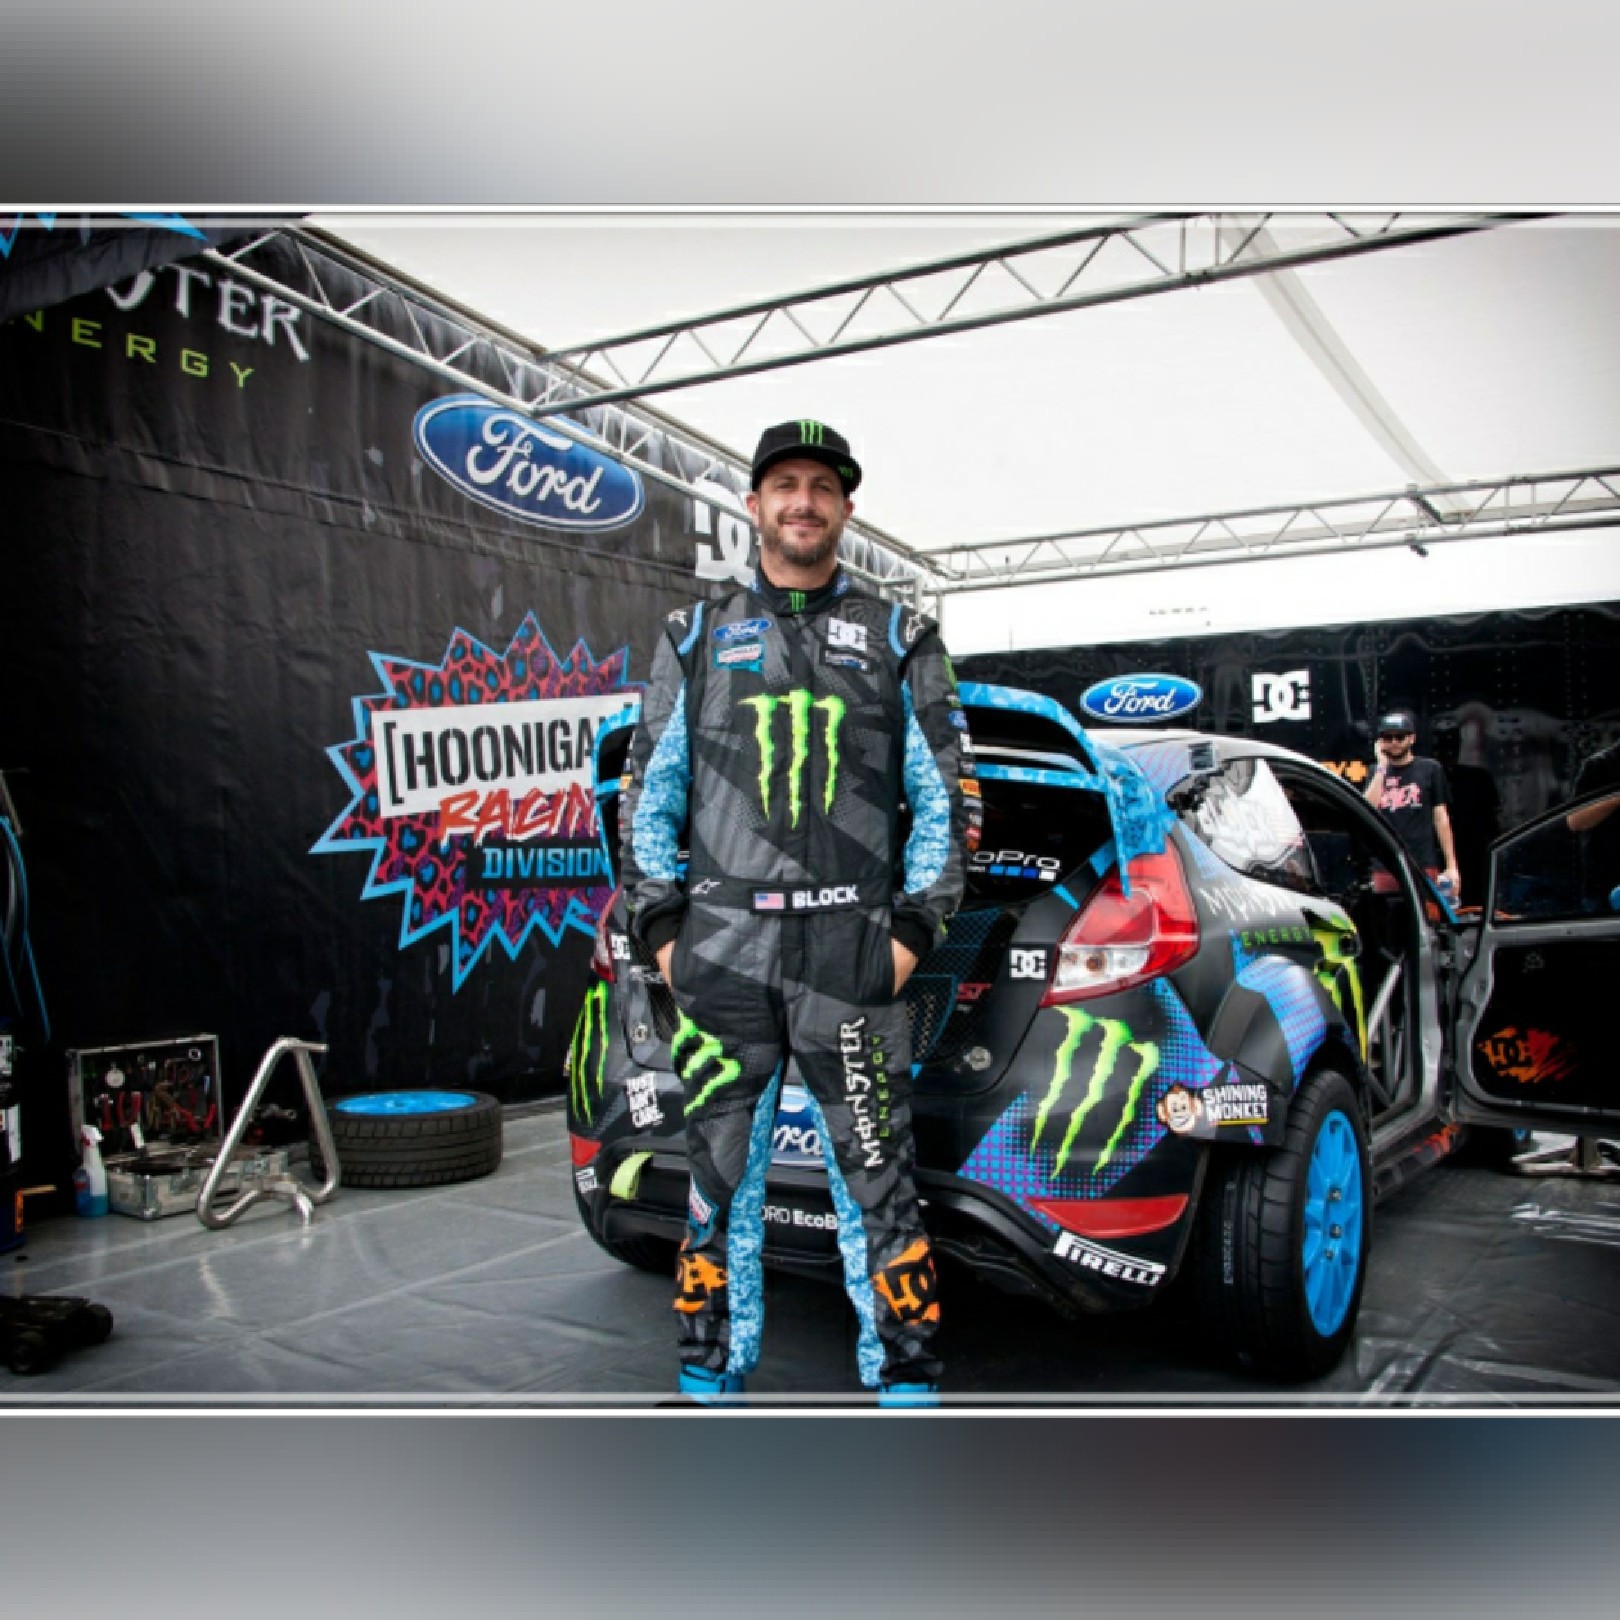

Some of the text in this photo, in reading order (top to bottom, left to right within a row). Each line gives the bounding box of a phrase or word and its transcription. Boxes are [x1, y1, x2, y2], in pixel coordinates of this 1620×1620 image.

[23, 310, 254, 388] NERGY
[466, 413, 603, 514] Ford
[1103, 681, 1178, 714] Ford
[1251, 671, 1312, 723] DC
[382, 714, 607, 806] [HOONIGA
[438, 782, 600, 848] RACIN
[482, 847, 614, 879] DIVISION
[973, 848, 1061, 870] oPro
[791, 884, 859, 911] BLOCK
[1009, 948, 1047, 980] DC
[1203, 1083, 1267, 1105] SHINING
[793, 1208, 838, 1230] EcoB
[1053, 1230, 1167, 1287] PIRELLI
